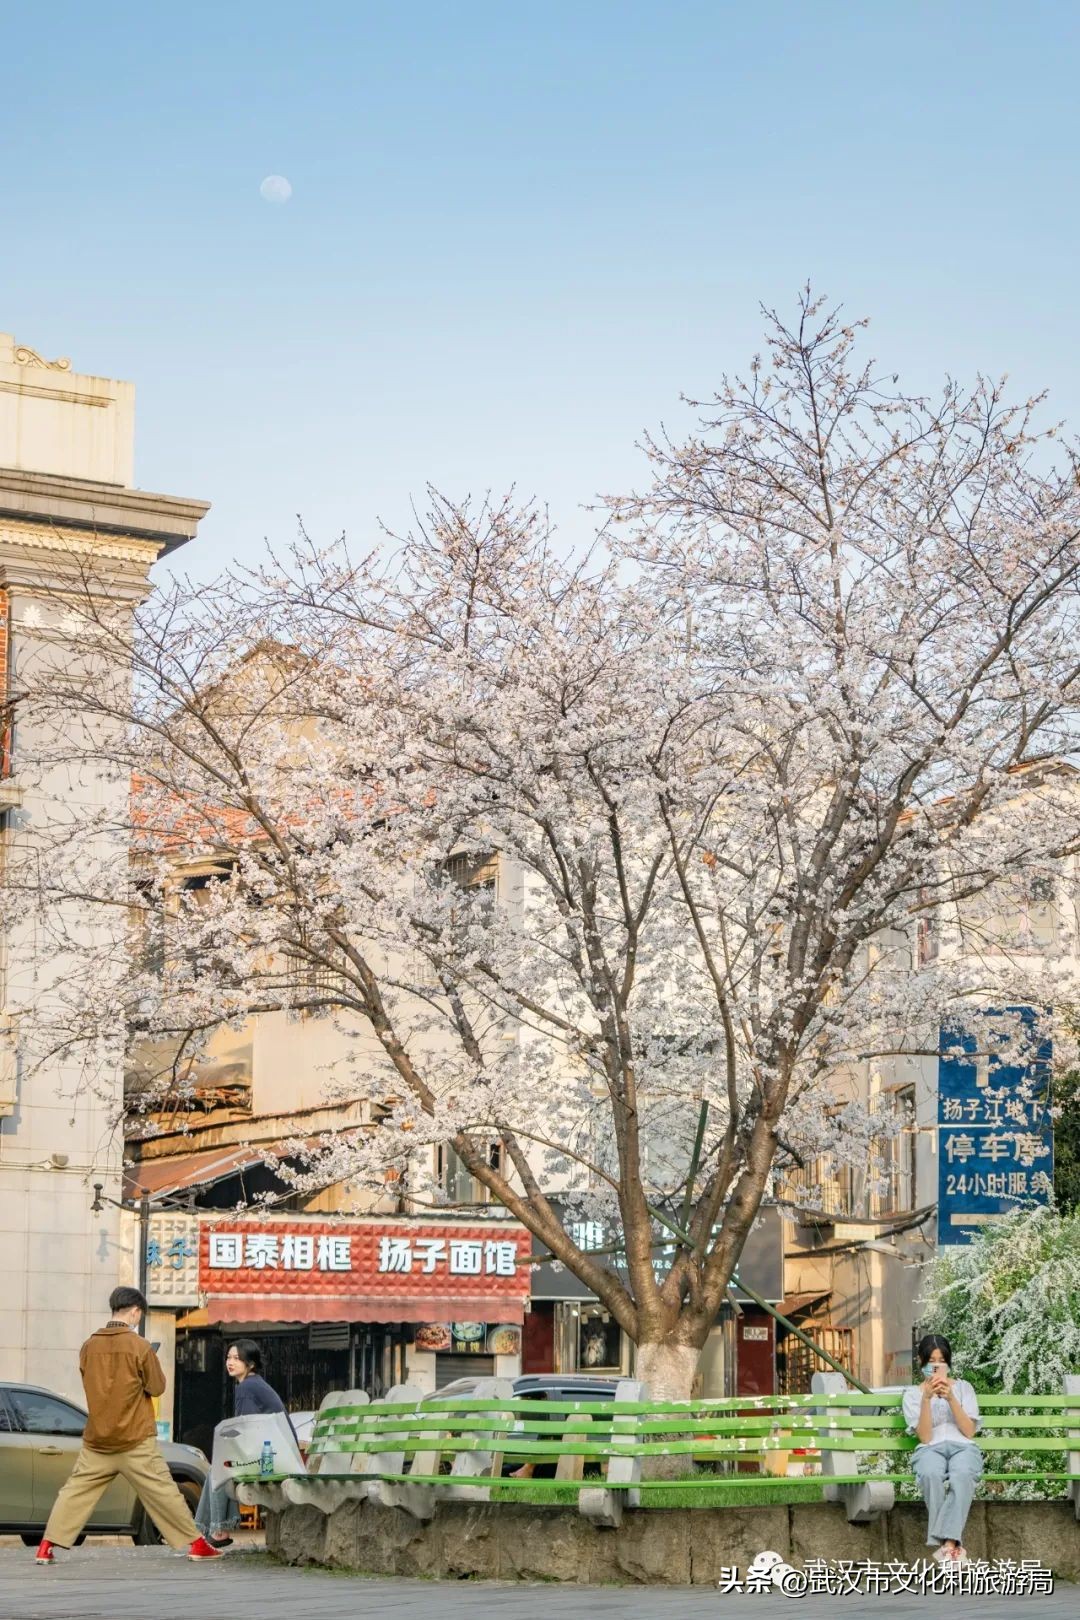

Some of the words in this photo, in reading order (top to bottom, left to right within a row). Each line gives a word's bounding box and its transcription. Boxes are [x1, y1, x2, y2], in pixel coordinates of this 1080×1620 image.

[943, 1098, 1046, 1121] 扬子江地下
[946, 1171, 1051, 1195] 24小时服务
[208, 1233, 352, 1271] 国泰相框
[379, 1237, 518, 1276] 扬子面馆
